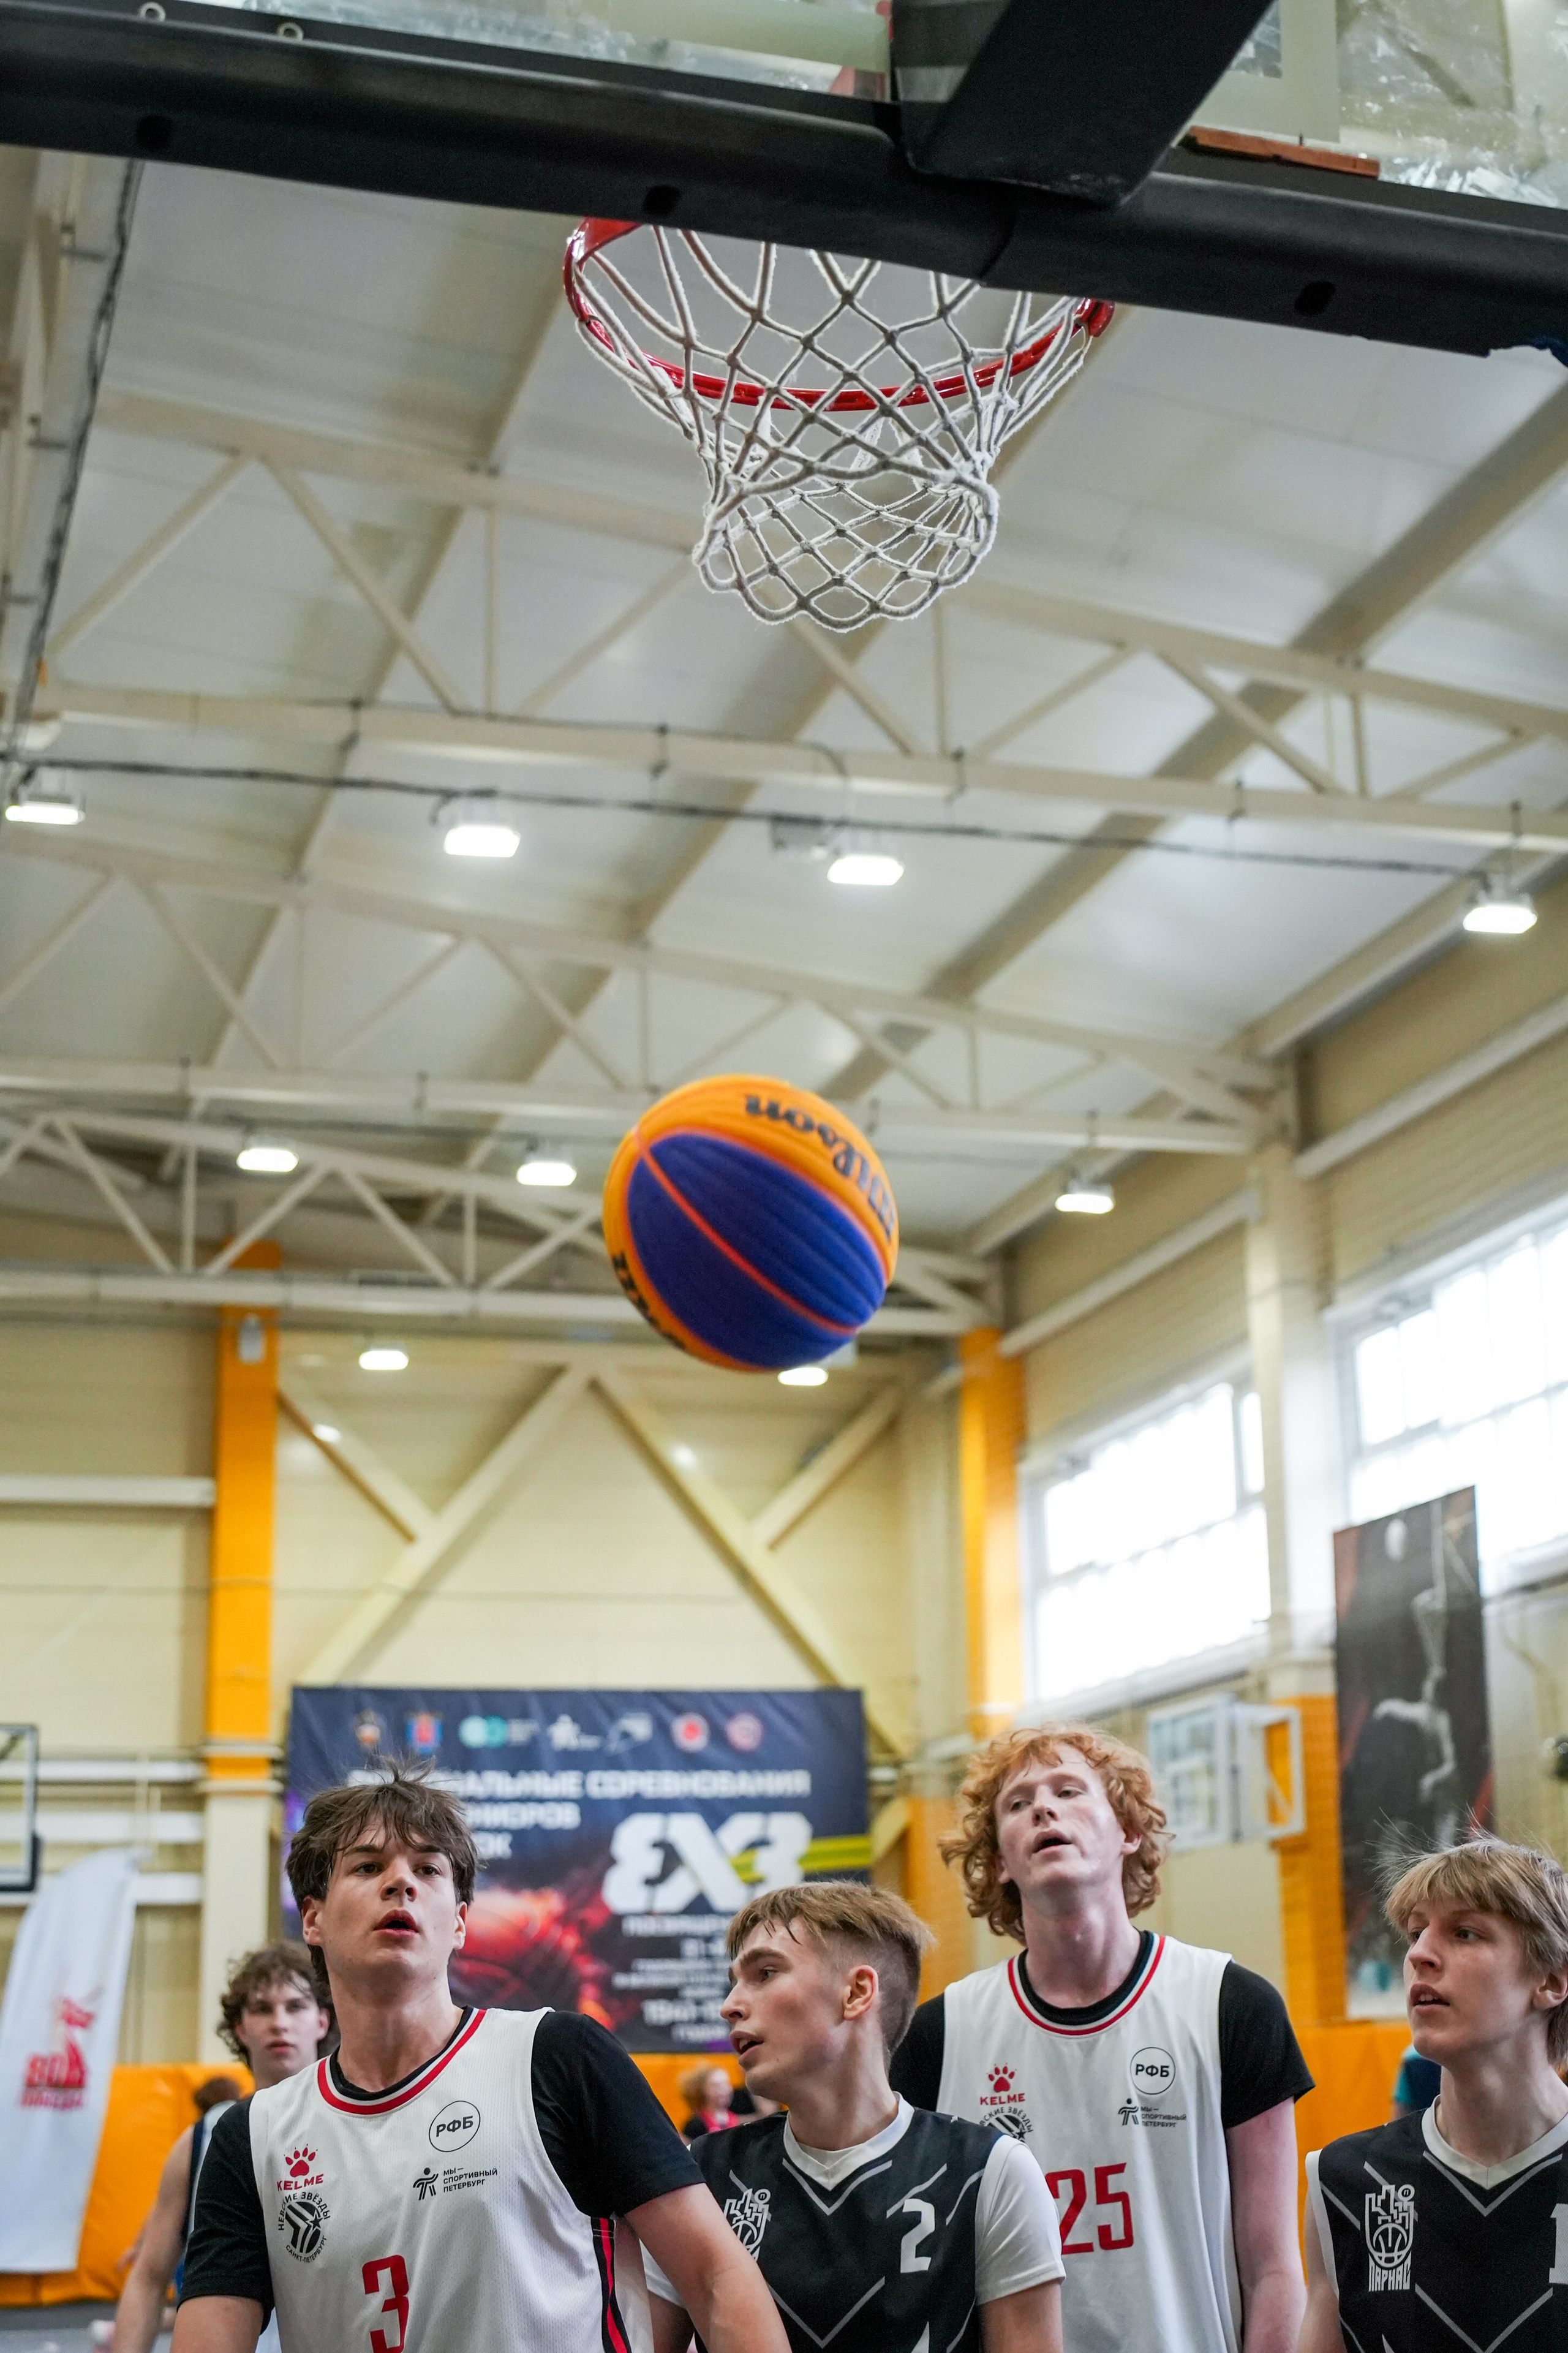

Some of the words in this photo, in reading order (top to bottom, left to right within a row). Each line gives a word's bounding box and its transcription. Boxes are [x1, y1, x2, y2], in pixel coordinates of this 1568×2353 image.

[1136, 2064, 1169, 2077] РФБ
[980, 2093, 1025, 2105] KELME
[435, 2115, 473, 2137] РФБ
[979, 2107, 1005, 2125] ВСКИЕ
[277, 2174, 324, 2192] KELME
[443, 2168, 498, 2184] СПОРТИВНЫЙ
[443, 2179, 486, 2192] ПЕТЕРБУРГ
[301, 2191, 331, 2219] ЗВЁЗДЫ
[1044, 2162, 1134, 2255] 25
[900, 2198, 935, 2273] 2
[285, 2235, 327, 2263] САНКТ-ПЕТЕРБУРГ
[361, 2254, 410, 2353] 3
